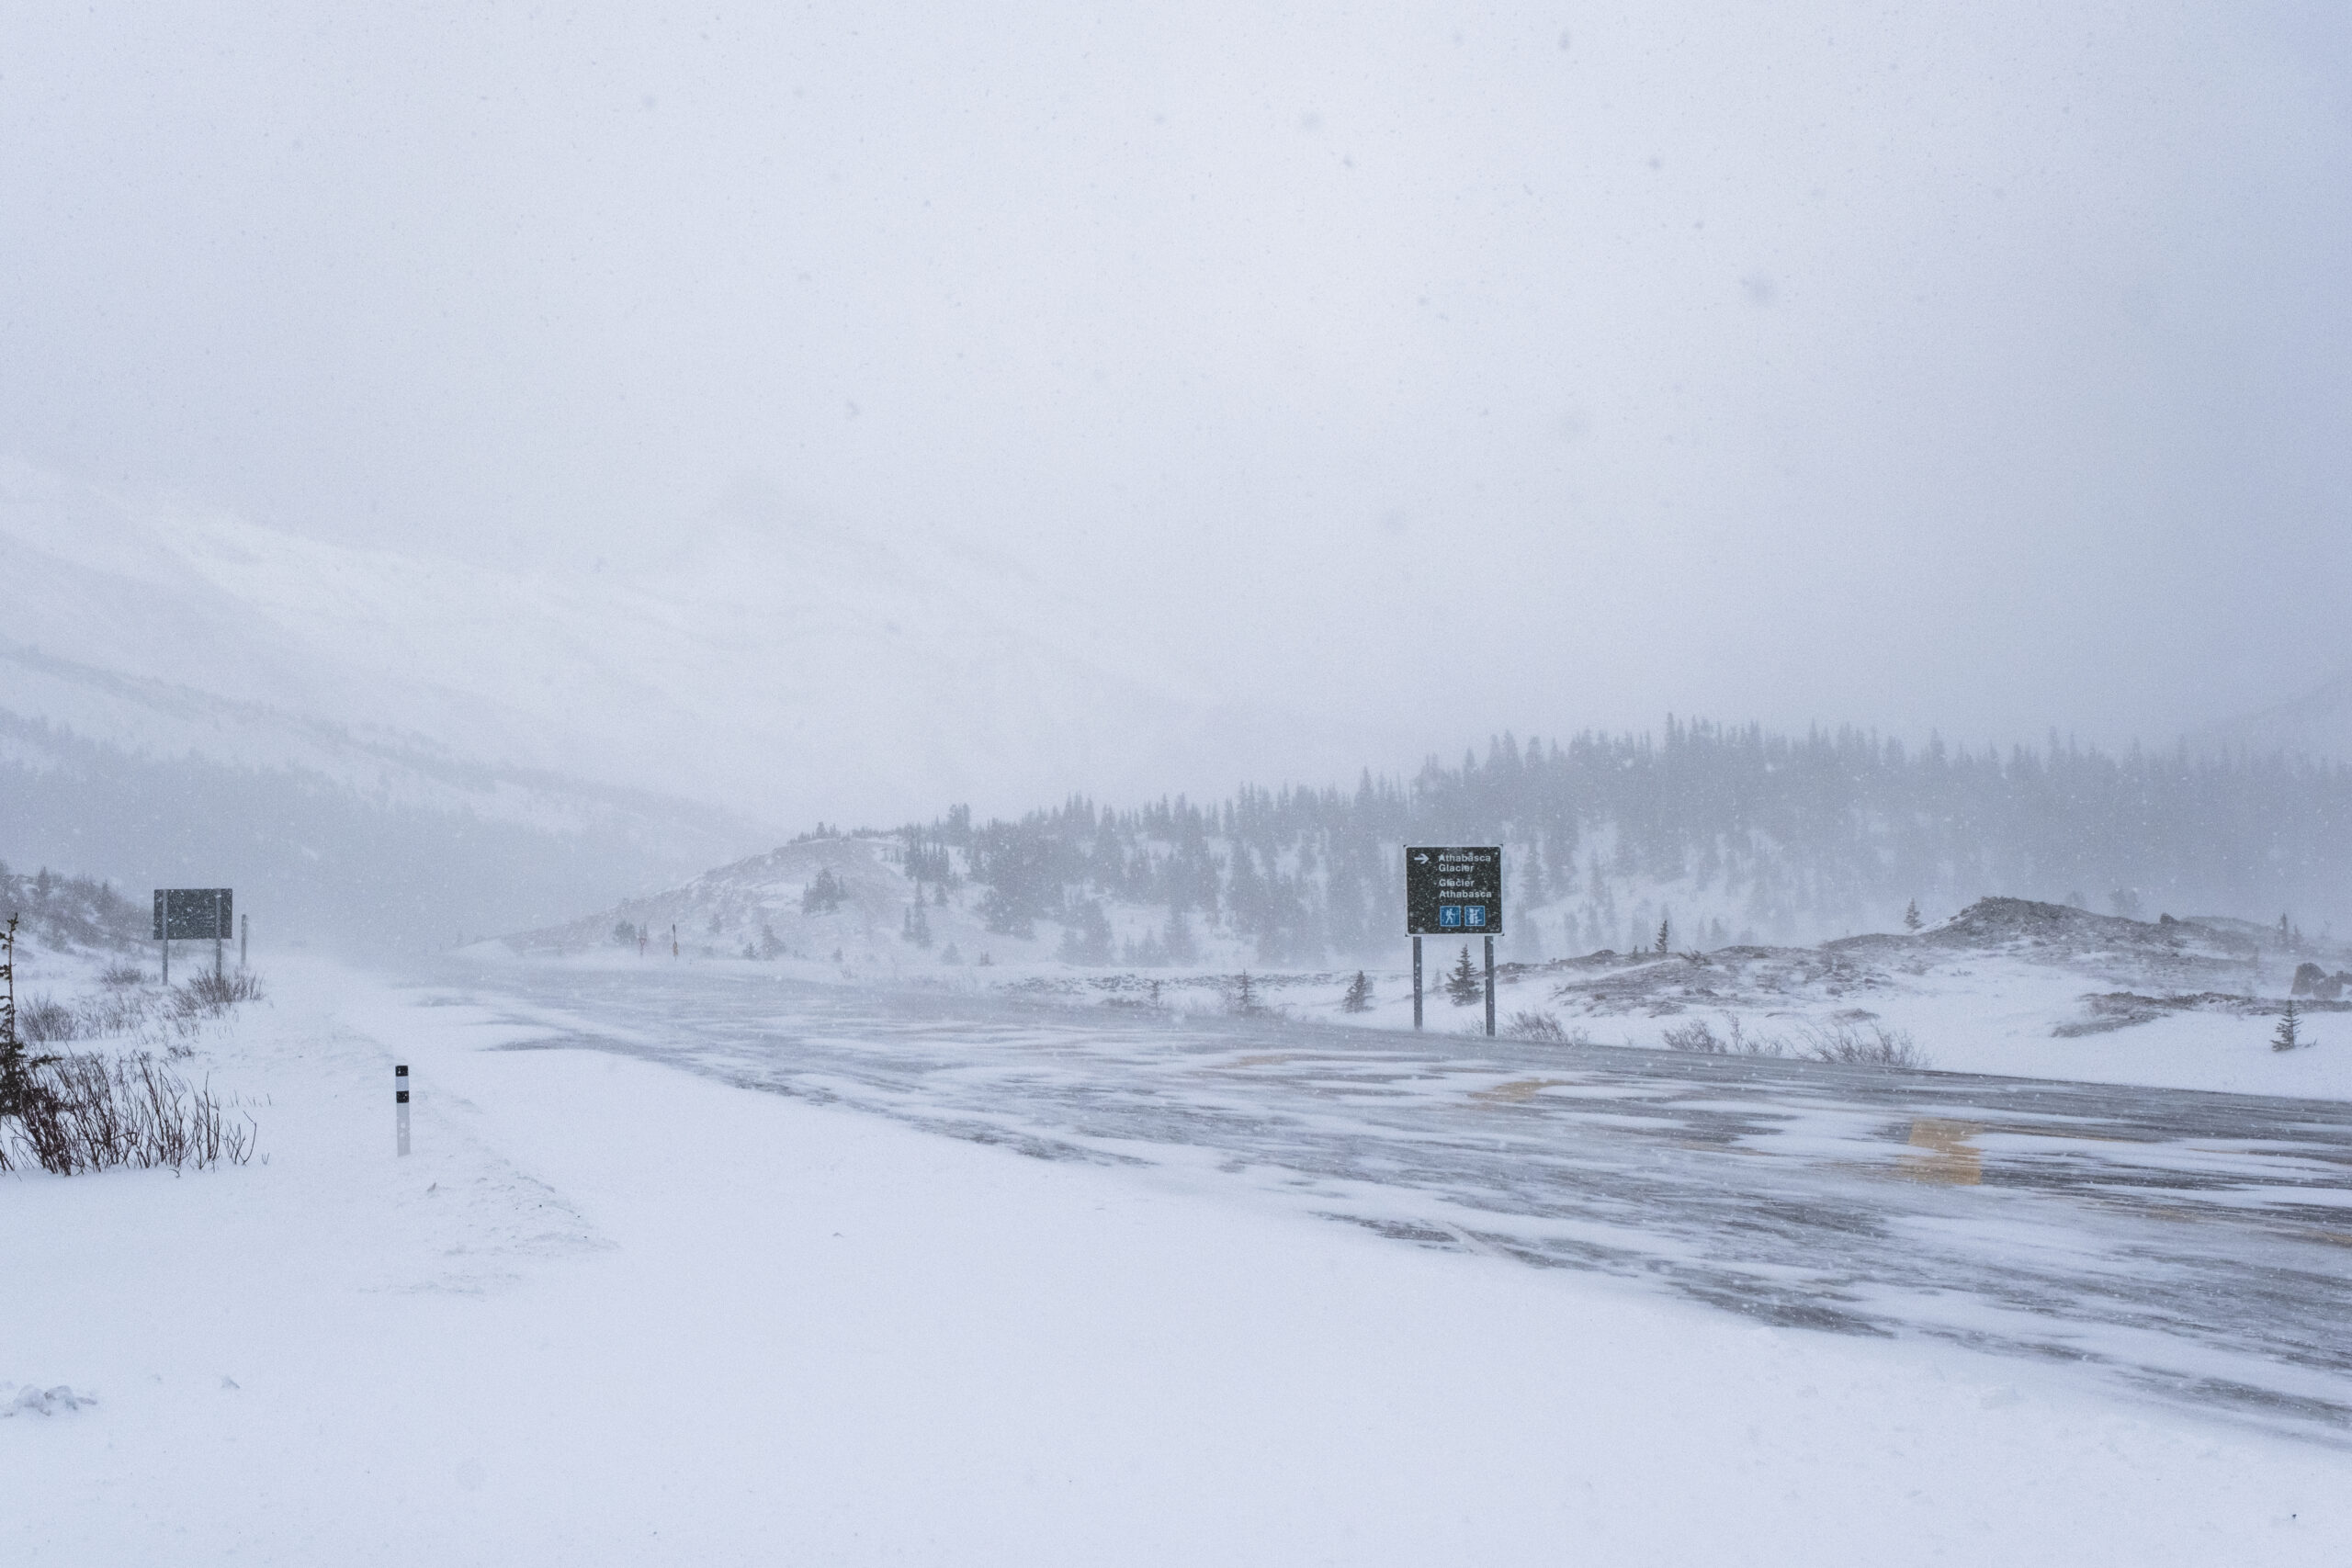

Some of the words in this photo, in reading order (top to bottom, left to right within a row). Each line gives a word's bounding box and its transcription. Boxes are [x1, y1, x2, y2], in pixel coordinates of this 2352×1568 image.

[1438, 854, 1491, 863] Athabasca
[1439, 863, 1475, 872] Glacier
[1439, 879, 1475, 887] Glacier
[1439, 890, 1492, 898] Athabasca
